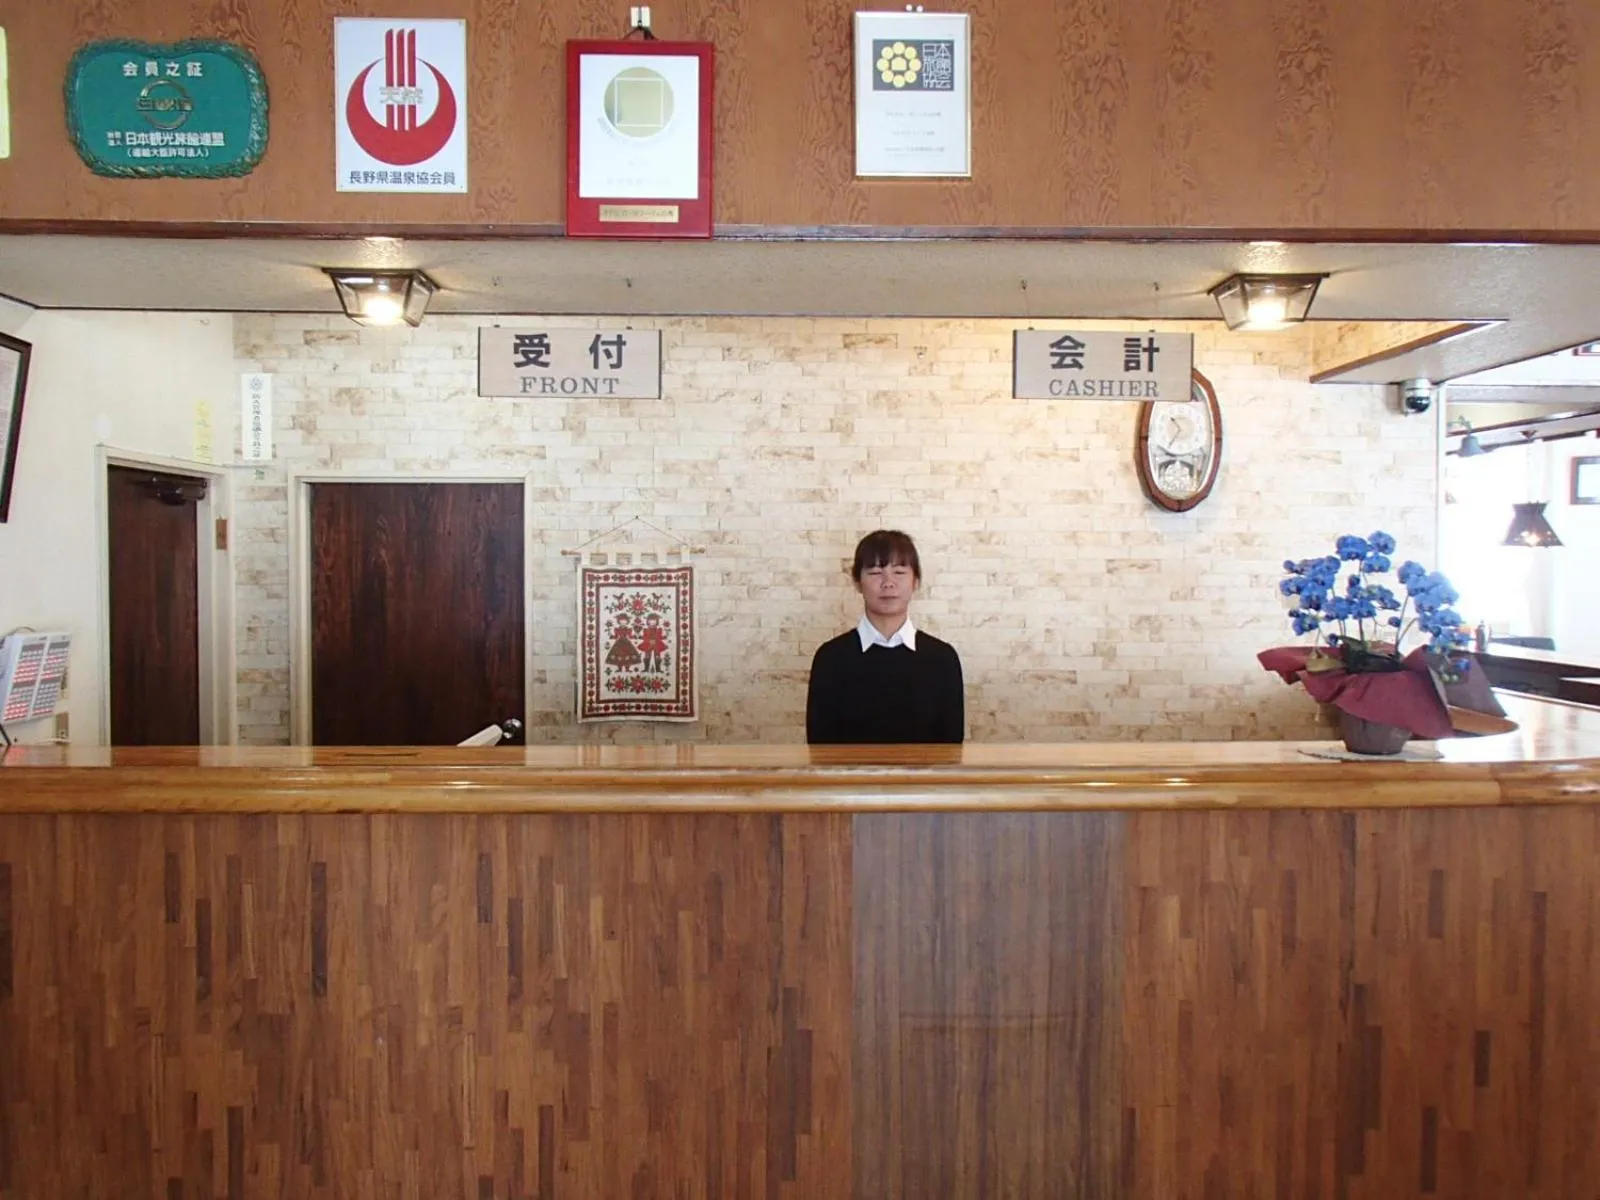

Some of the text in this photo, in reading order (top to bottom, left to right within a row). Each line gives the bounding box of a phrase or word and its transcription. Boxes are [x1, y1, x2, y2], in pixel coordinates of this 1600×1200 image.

[122, 61, 203, 77] 会員之証
[350, 170, 456, 186] 長野県温泉協会員
[513, 332, 627, 370] 受付
[1049, 335, 1160, 373] 会計
[521, 376, 620, 395] FRONT
[1049, 379, 1160, 398] CASHIER
